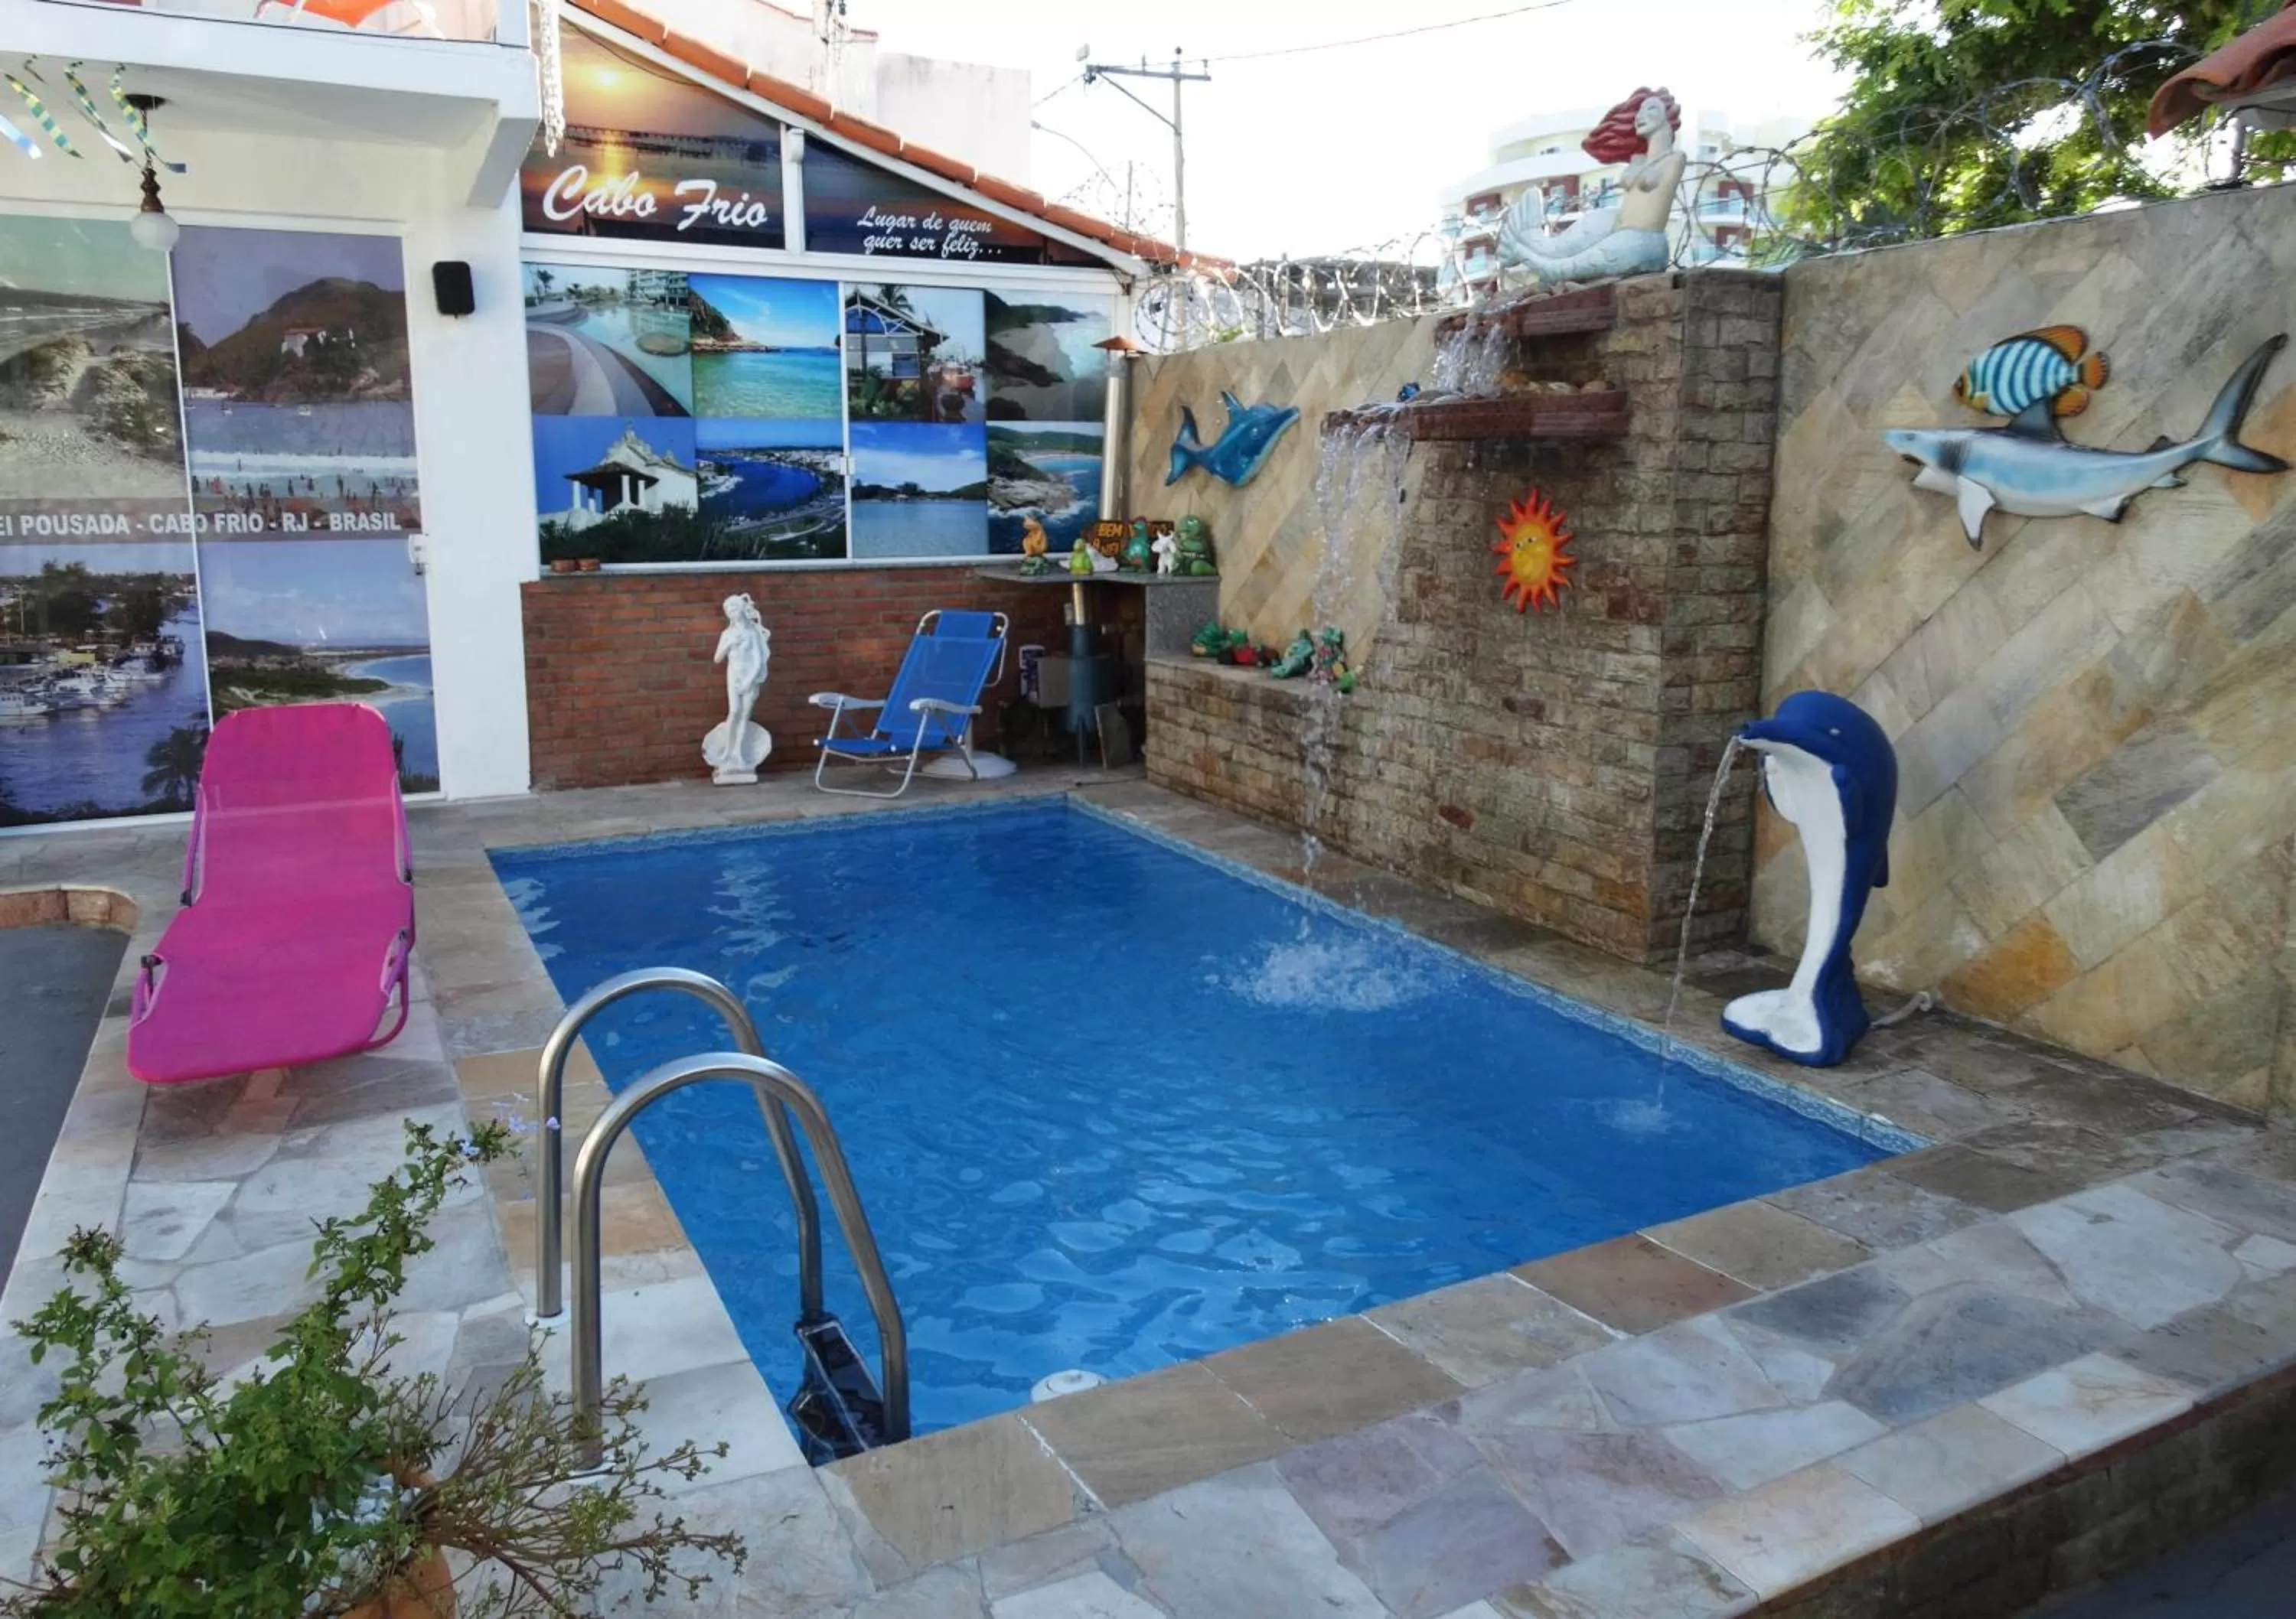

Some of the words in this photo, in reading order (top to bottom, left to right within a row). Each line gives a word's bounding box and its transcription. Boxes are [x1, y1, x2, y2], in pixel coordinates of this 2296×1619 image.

[543, 165, 657, 221] Cabo
[674, 179, 768, 231] Frio
[857, 206, 915, 233] Lugar
[922, 211, 943, 230] de
[948, 218, 993, 234] quem
[863, 235, 902, 255] quer
[910, 238, 936, 251] ser
[21, 513, 130, 536] POUSADA
[149, 514, 207, 533] CABO
[214, 513, 263, 533] FRIO
[282, 513, 308, 532] RJ
[329, 512, 402, 531] BRASIL
